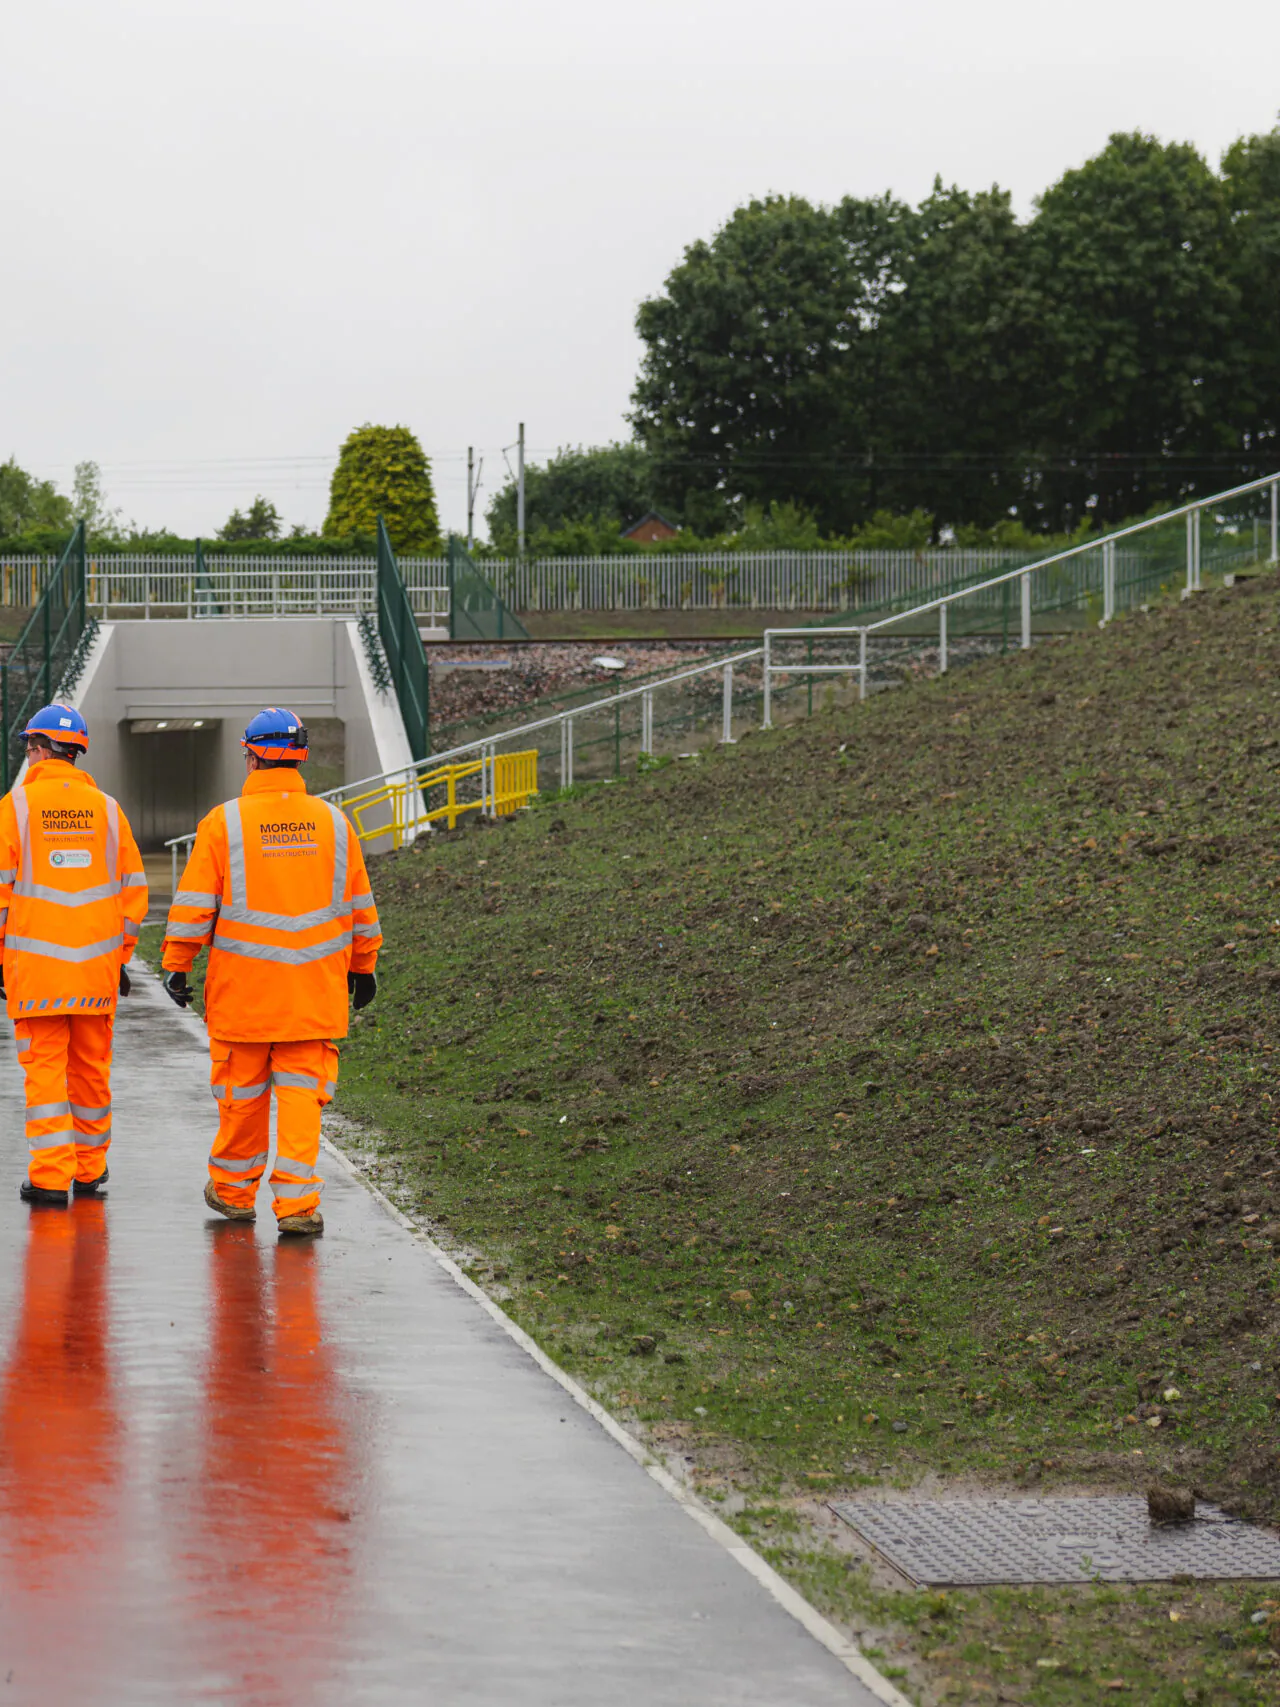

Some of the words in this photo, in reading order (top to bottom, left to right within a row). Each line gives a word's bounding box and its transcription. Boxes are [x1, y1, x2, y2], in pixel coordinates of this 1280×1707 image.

[41, 809, 94, 819] MORGAN
[42, 820, 93, 829] SINDALL
[260, 822, 316, 833] MORGAN
[261, 833, 315, 844] SINDALL
